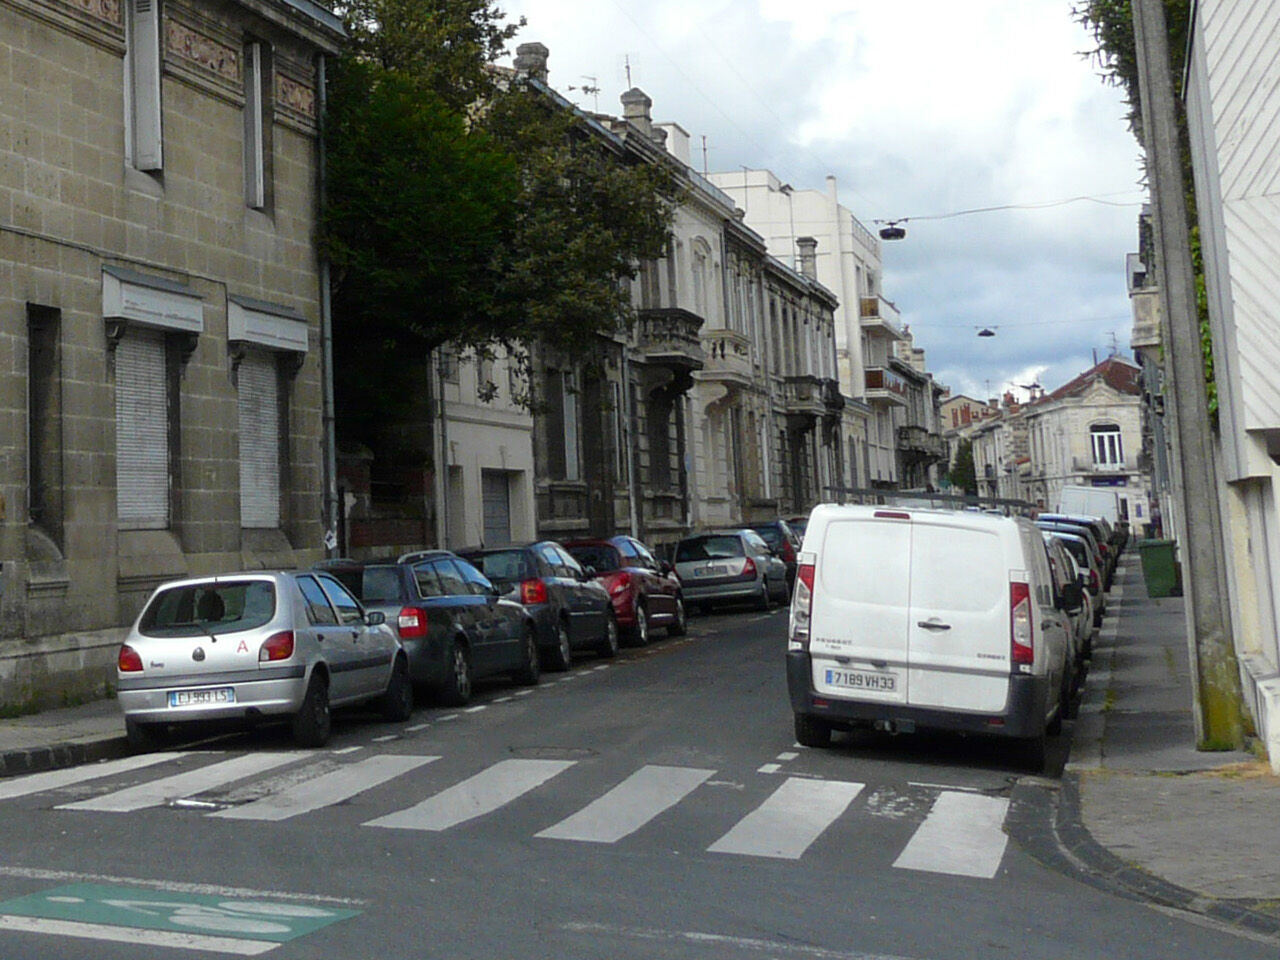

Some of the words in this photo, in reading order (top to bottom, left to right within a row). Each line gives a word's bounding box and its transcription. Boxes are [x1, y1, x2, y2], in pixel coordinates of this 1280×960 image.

[236, 639, 249, 654] A
[834, 671, 864, 688] 7189
[865, 674, 880, 689] VH
[880, 676, 895, 690] 33
